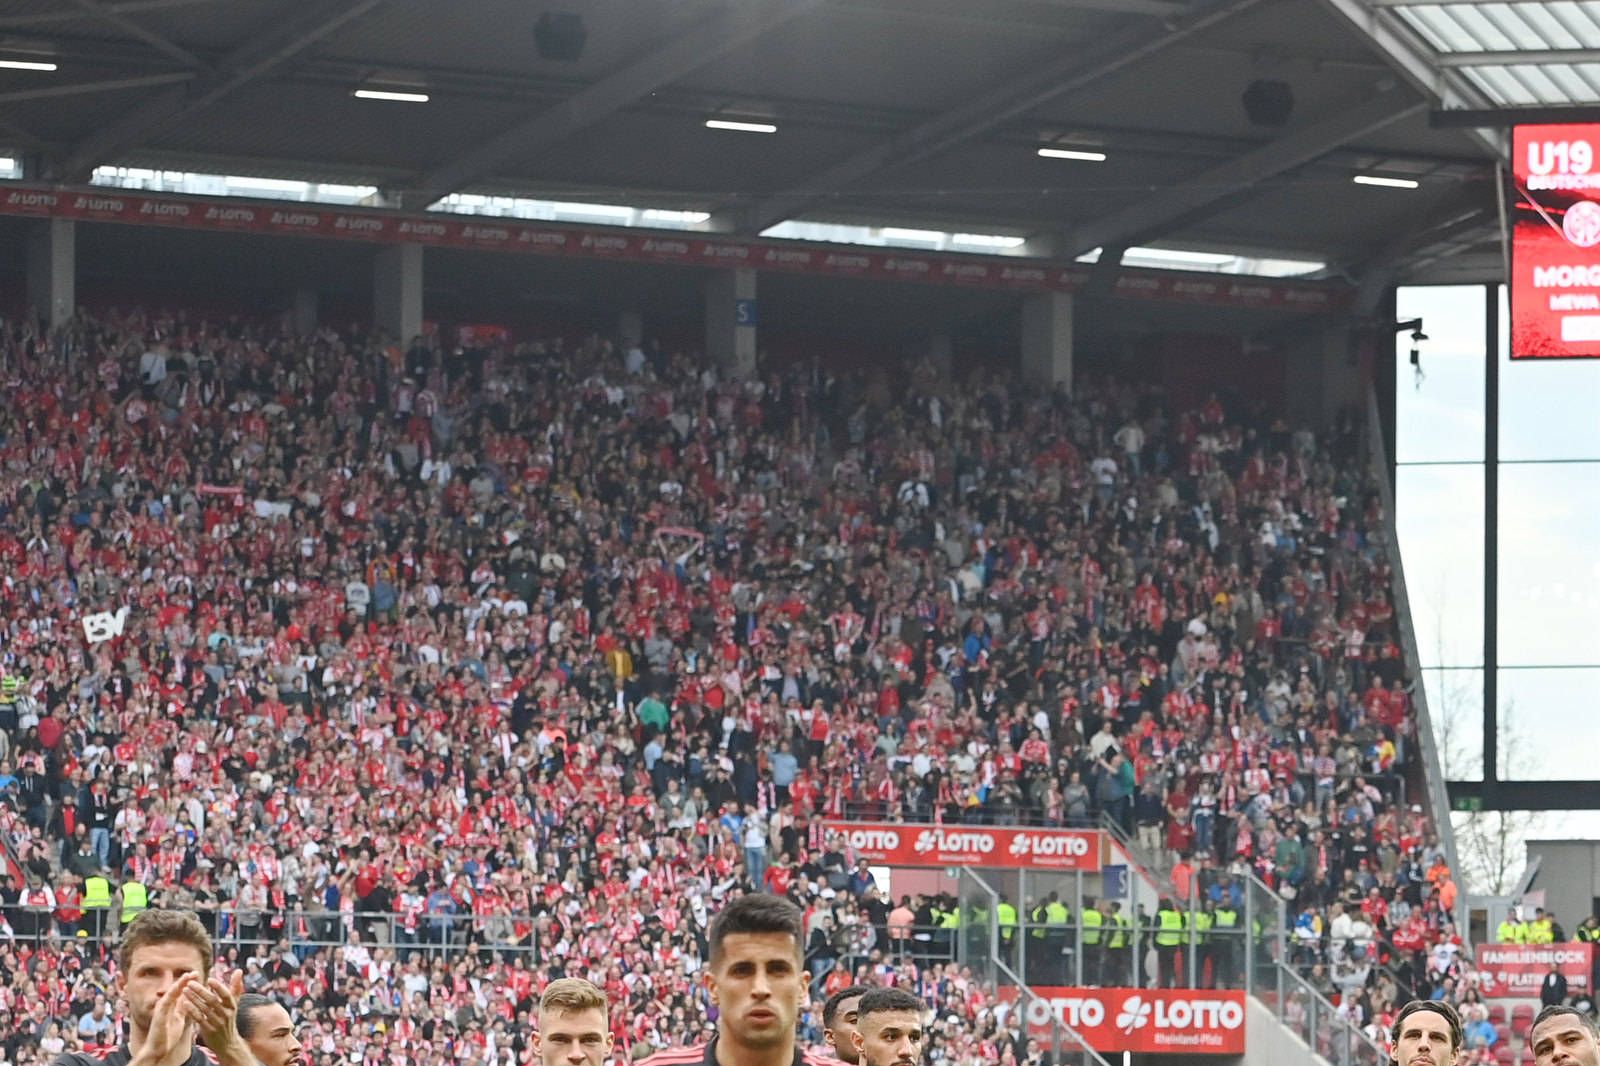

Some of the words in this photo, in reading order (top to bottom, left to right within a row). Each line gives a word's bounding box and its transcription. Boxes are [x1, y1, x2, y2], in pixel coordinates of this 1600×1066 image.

[1527, 140, 1593, 175] U19
[937, 831, 995, 852] LOTTO
[1032, 835, 1088, 856] LOTTO
[1482, 951, 1585, 965] FAMILIENBLOCK
[1154, 1000, 1243, 1029] LOTTO
